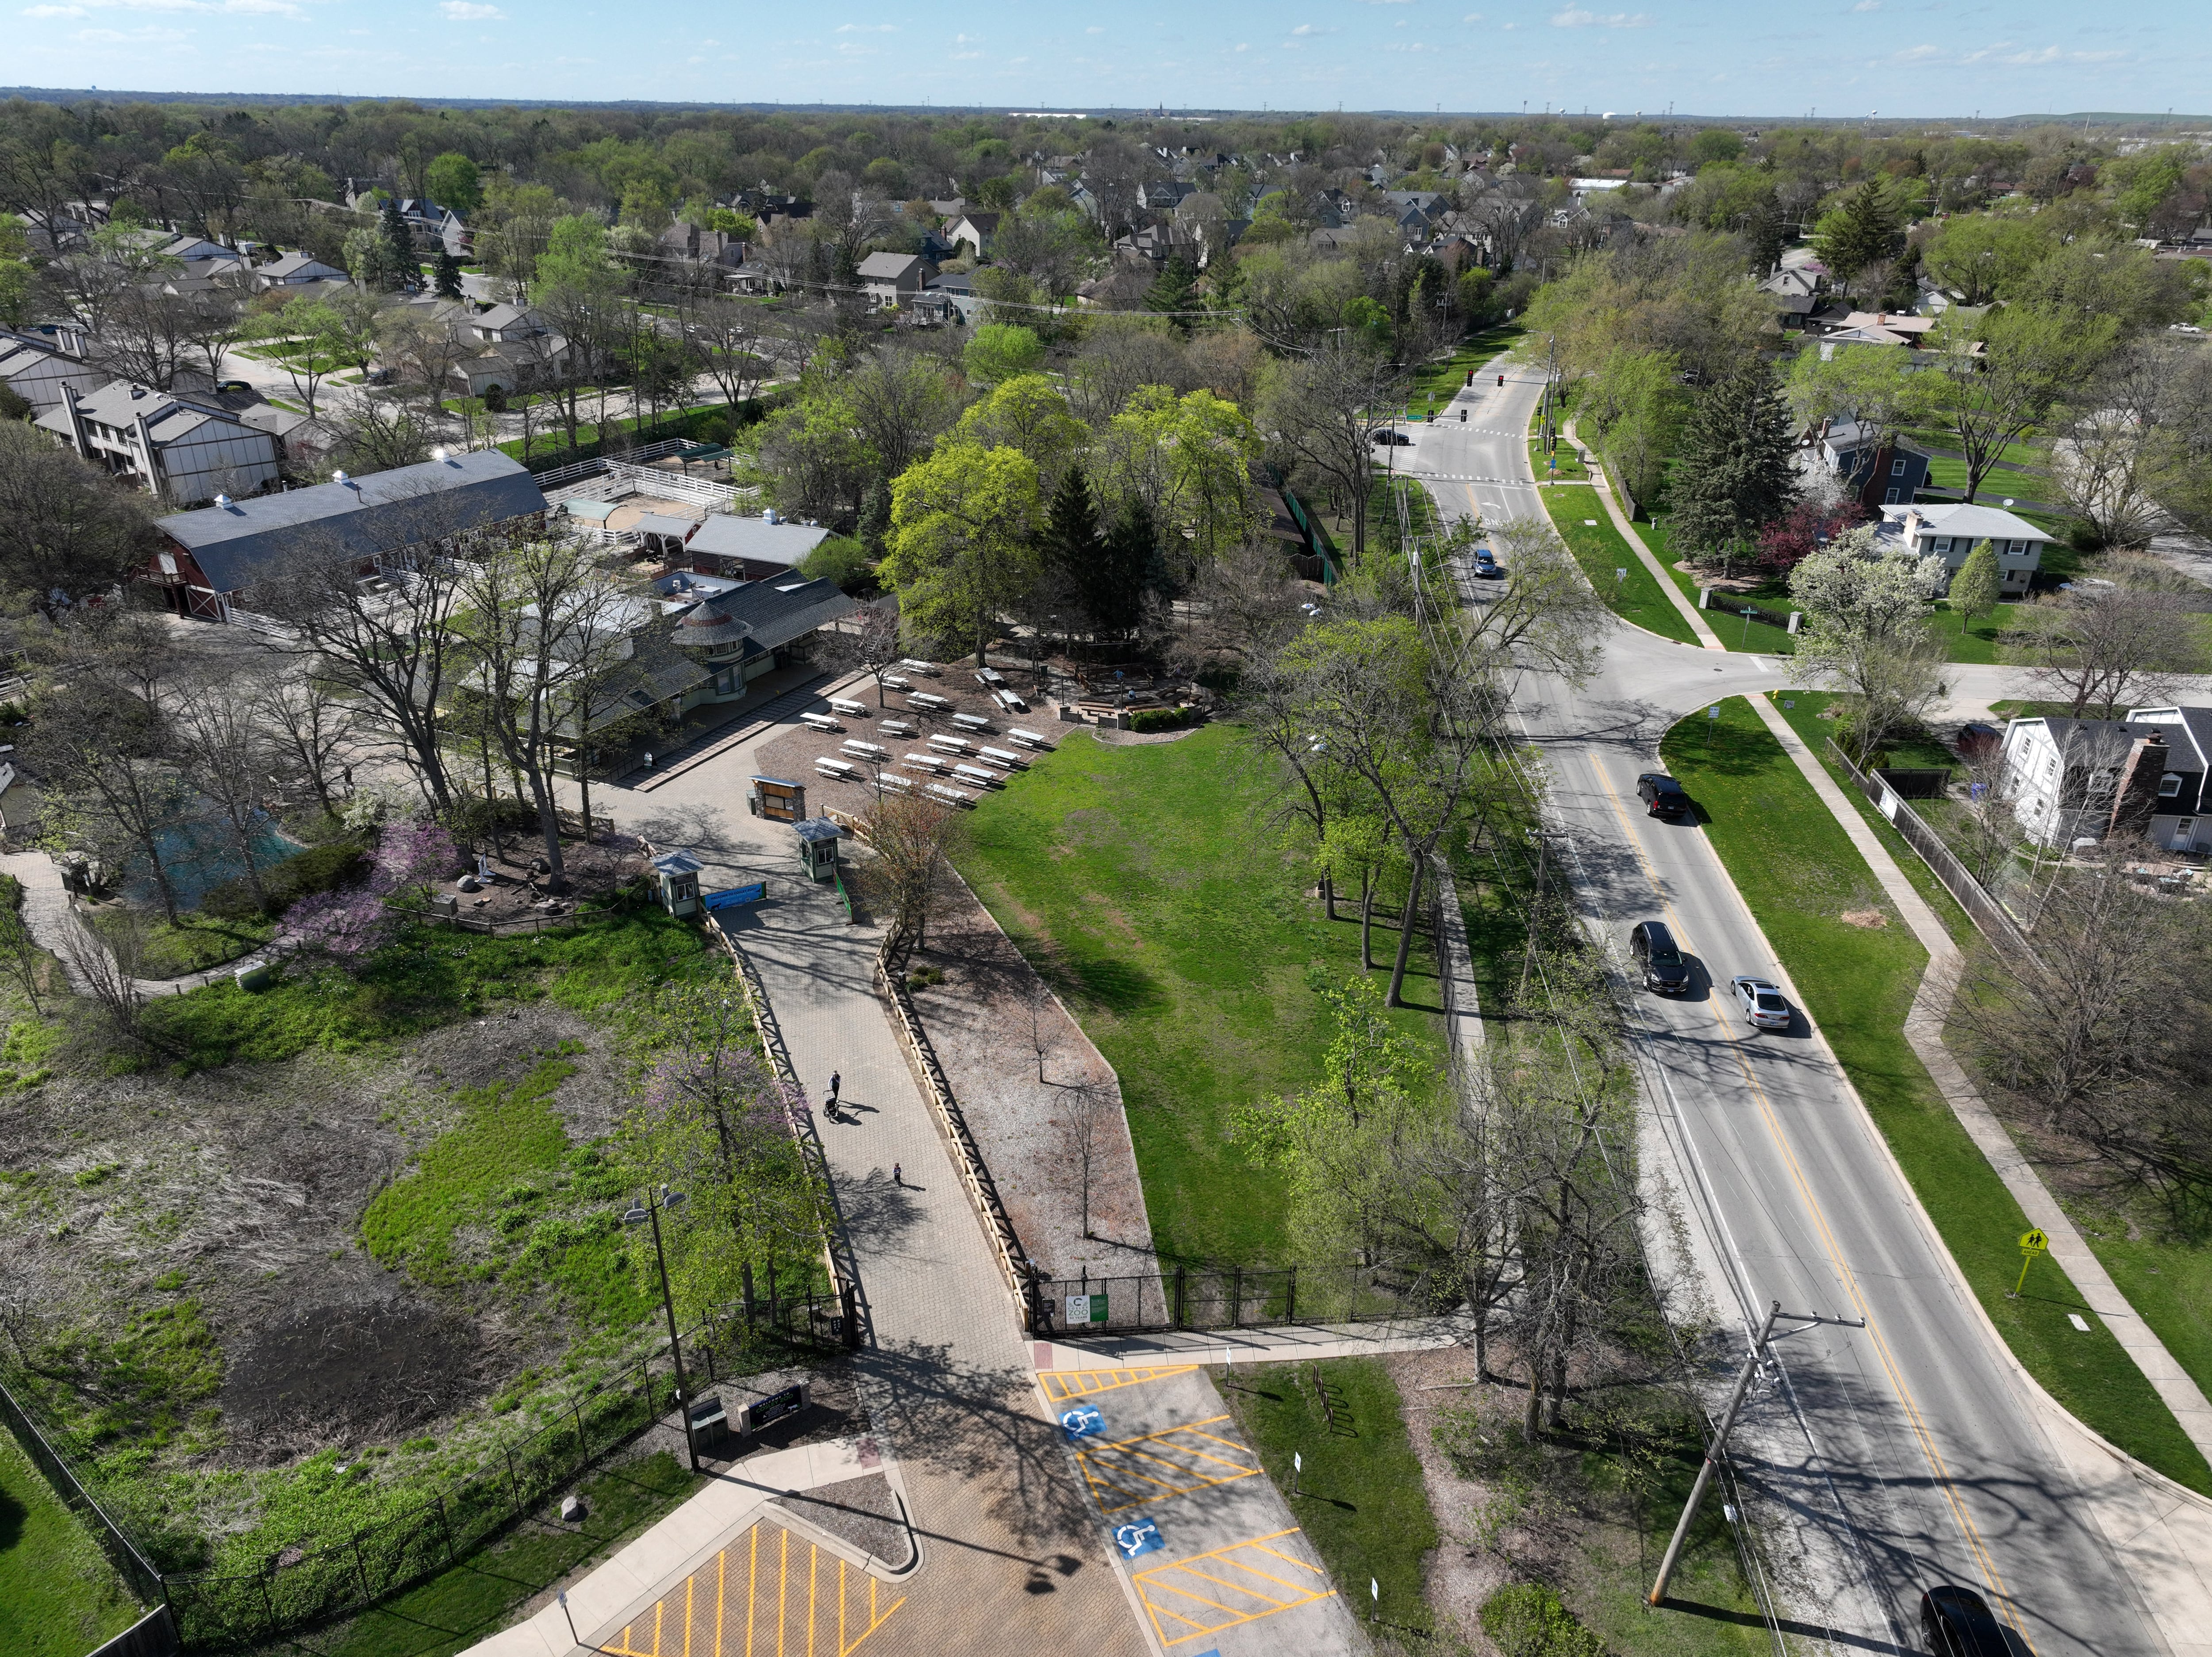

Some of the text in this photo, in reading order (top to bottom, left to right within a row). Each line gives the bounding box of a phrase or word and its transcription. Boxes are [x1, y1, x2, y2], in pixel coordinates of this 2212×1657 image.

[756, 1400, 779, 1413] COSLEY
[780, 1393, 793, 1403] ZOO
[759, 1396, 781, 1408] WELCOME
